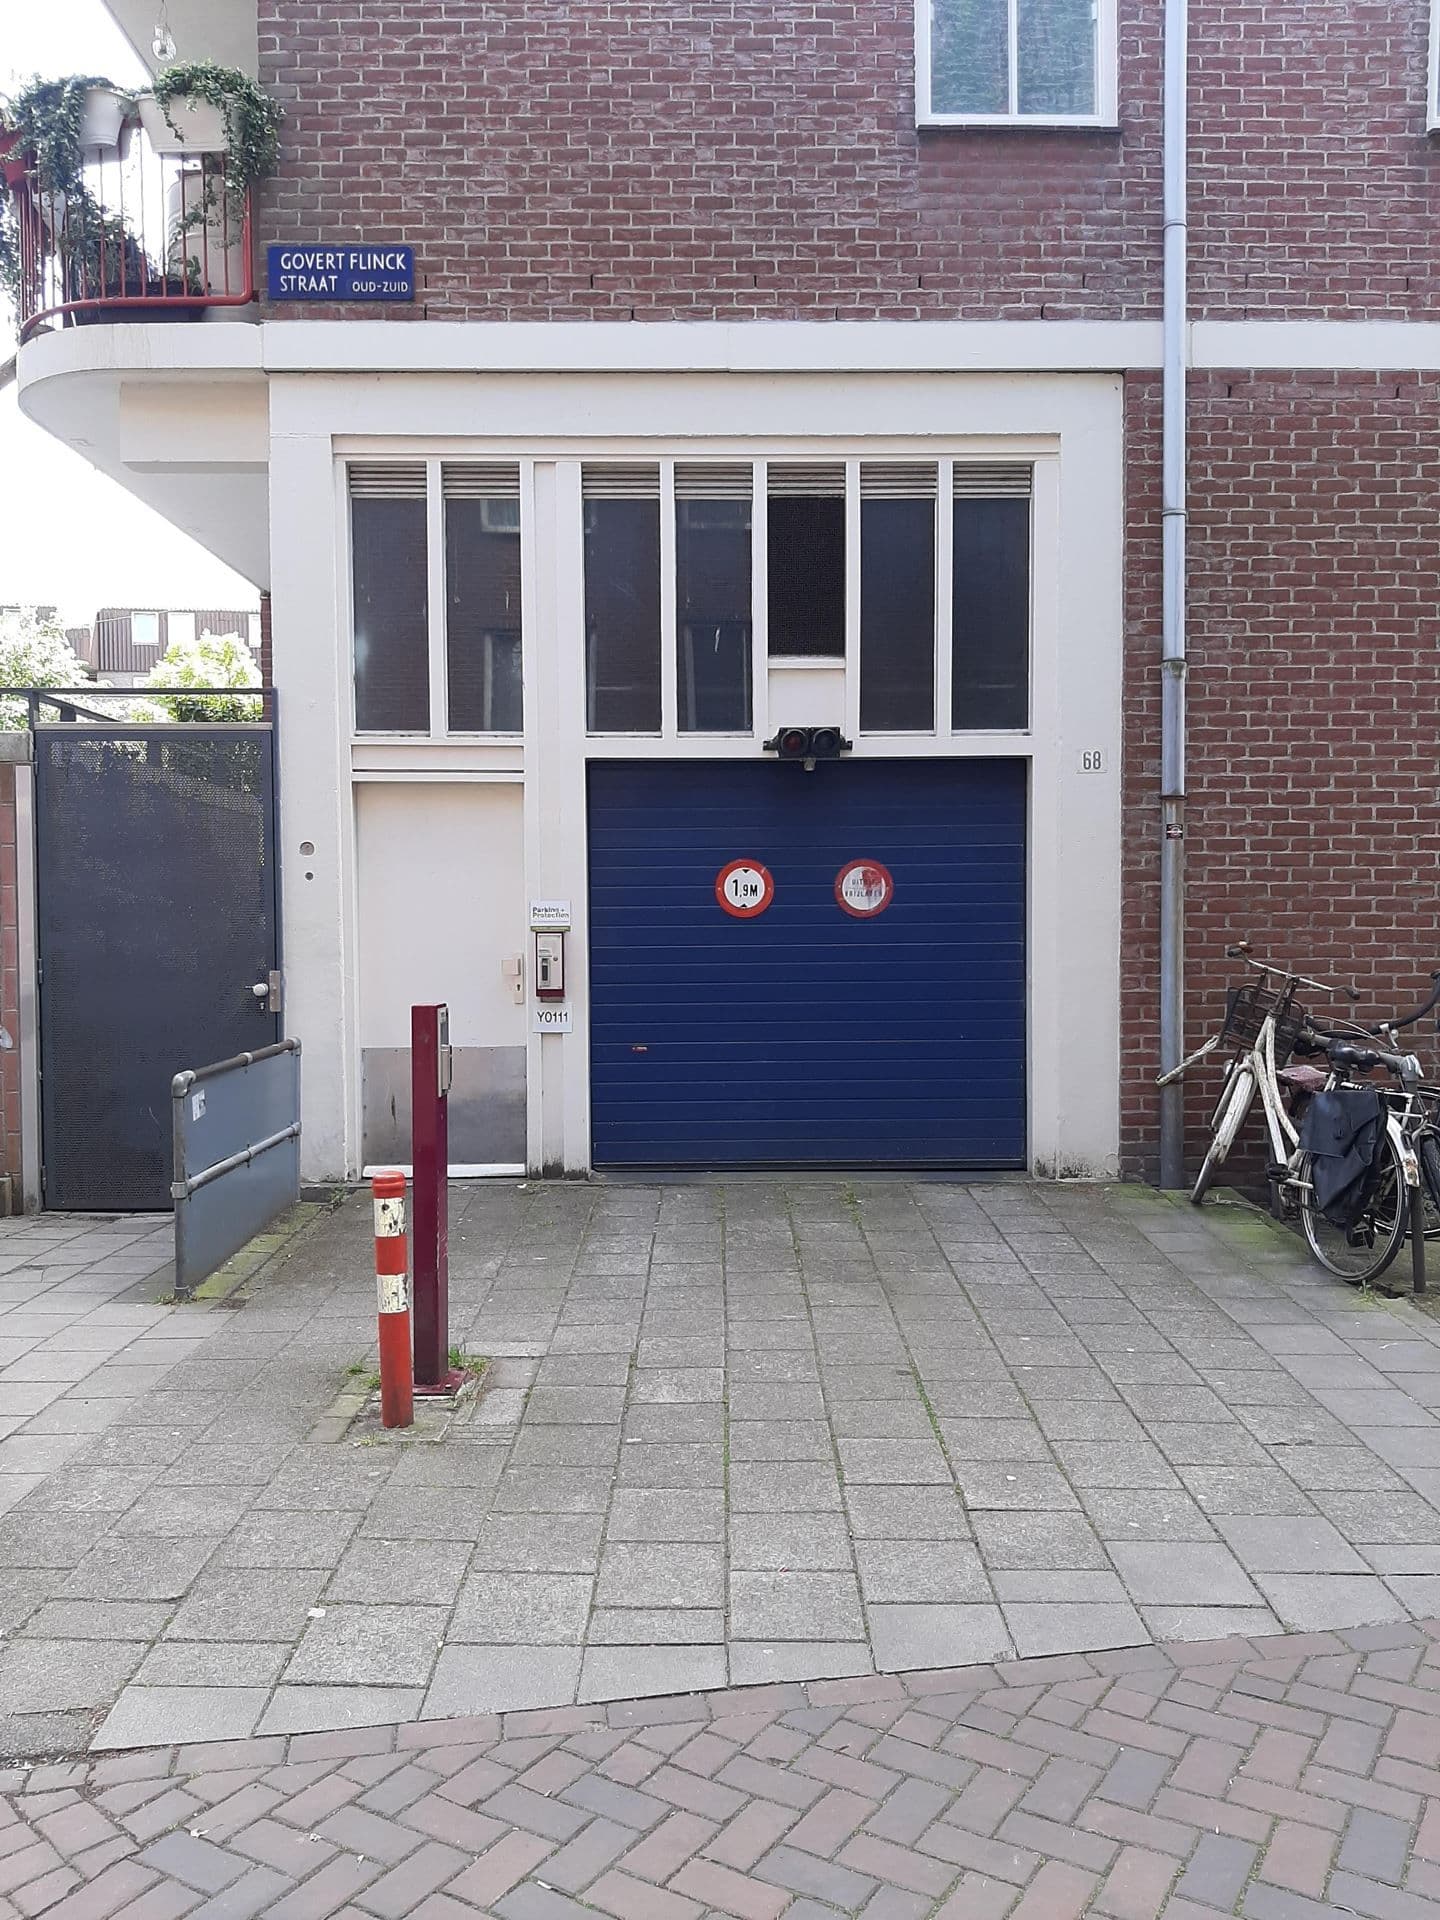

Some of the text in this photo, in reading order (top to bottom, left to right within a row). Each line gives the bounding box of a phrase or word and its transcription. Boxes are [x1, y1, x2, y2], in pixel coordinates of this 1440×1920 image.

[280, 253, 406, 270] GOVERT FLINCK
[280, 275, 408, 292] STRAAT OUD-ZUID
[1083, 751, 1101, 770] 68
